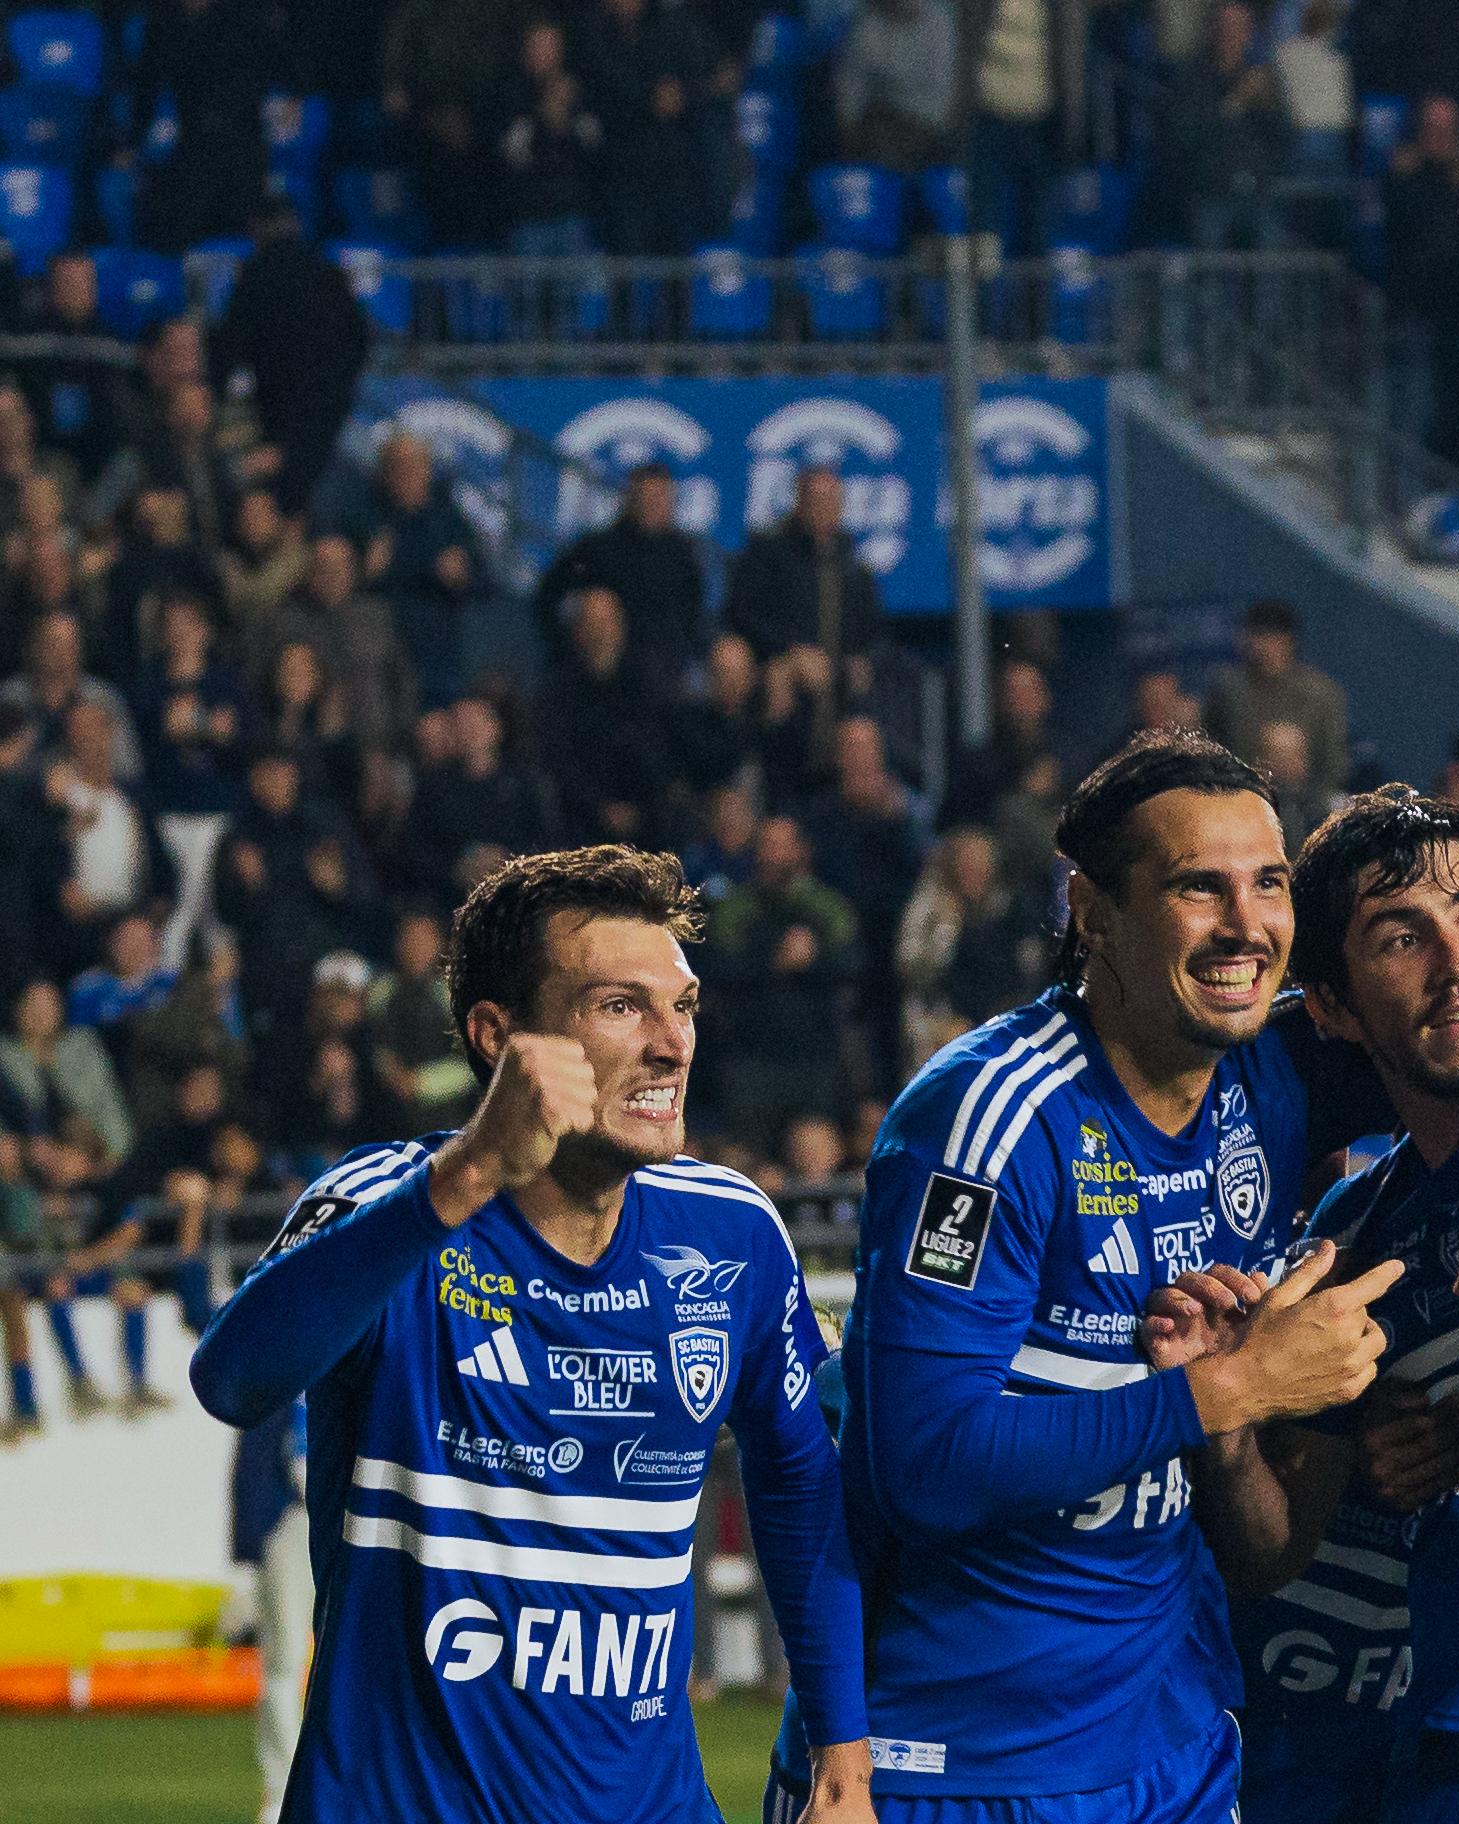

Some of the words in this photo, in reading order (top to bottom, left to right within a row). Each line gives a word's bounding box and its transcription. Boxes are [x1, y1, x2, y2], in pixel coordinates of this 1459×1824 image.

[938, 1194, 974, 1236] 2
[674, 1301, 731, 1316] RONCAGLIA
[677, 1340, 691, 1355] SC
[690, 1337, 721, 1354] BASTIA
[1066, 1327, 1111, 1345] BASTIA
[547, 1353, 658, 1384] L'OLIVIER
[573, 1381, 633, 1410] BLEU
[437, 1420, 546, 1464] E.Leclerc
[452, 1447, 499, 1470] BASTIA
[513, 1606, 676, 1698] FANTI
[630, 1695, 668, 1723] GROUPE
